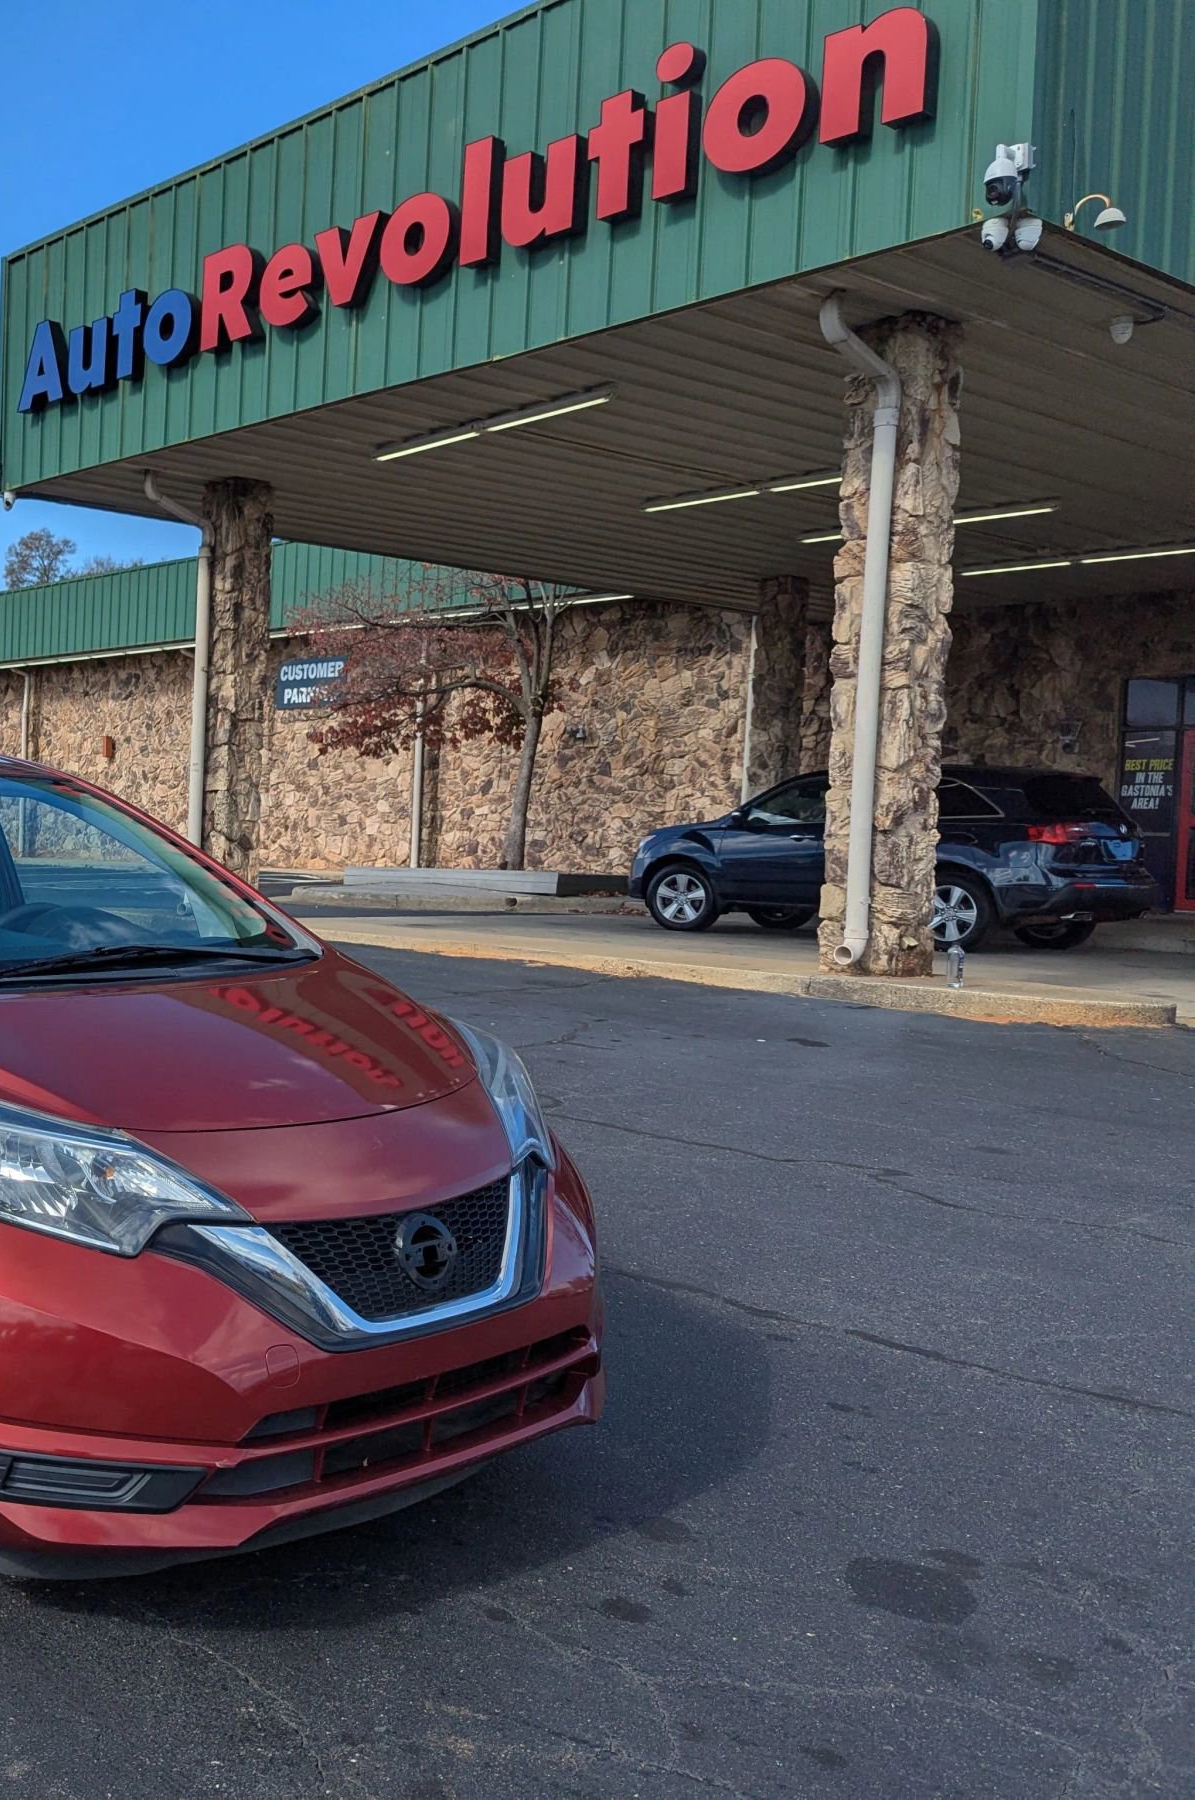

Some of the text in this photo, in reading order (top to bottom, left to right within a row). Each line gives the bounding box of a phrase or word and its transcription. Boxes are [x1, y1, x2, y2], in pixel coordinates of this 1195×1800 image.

[17, 6, 932, 414] AutoRevolution
[280, 661, 344, 682] CUSTOMER
[1124, 758, 1175, 771] BEST PRICE
[1135, 771, 1165, 784] IN THE
[1120, 784, 1174, 797] GASTONIA'S
[1130, 797, 1160, 810] AREA!
